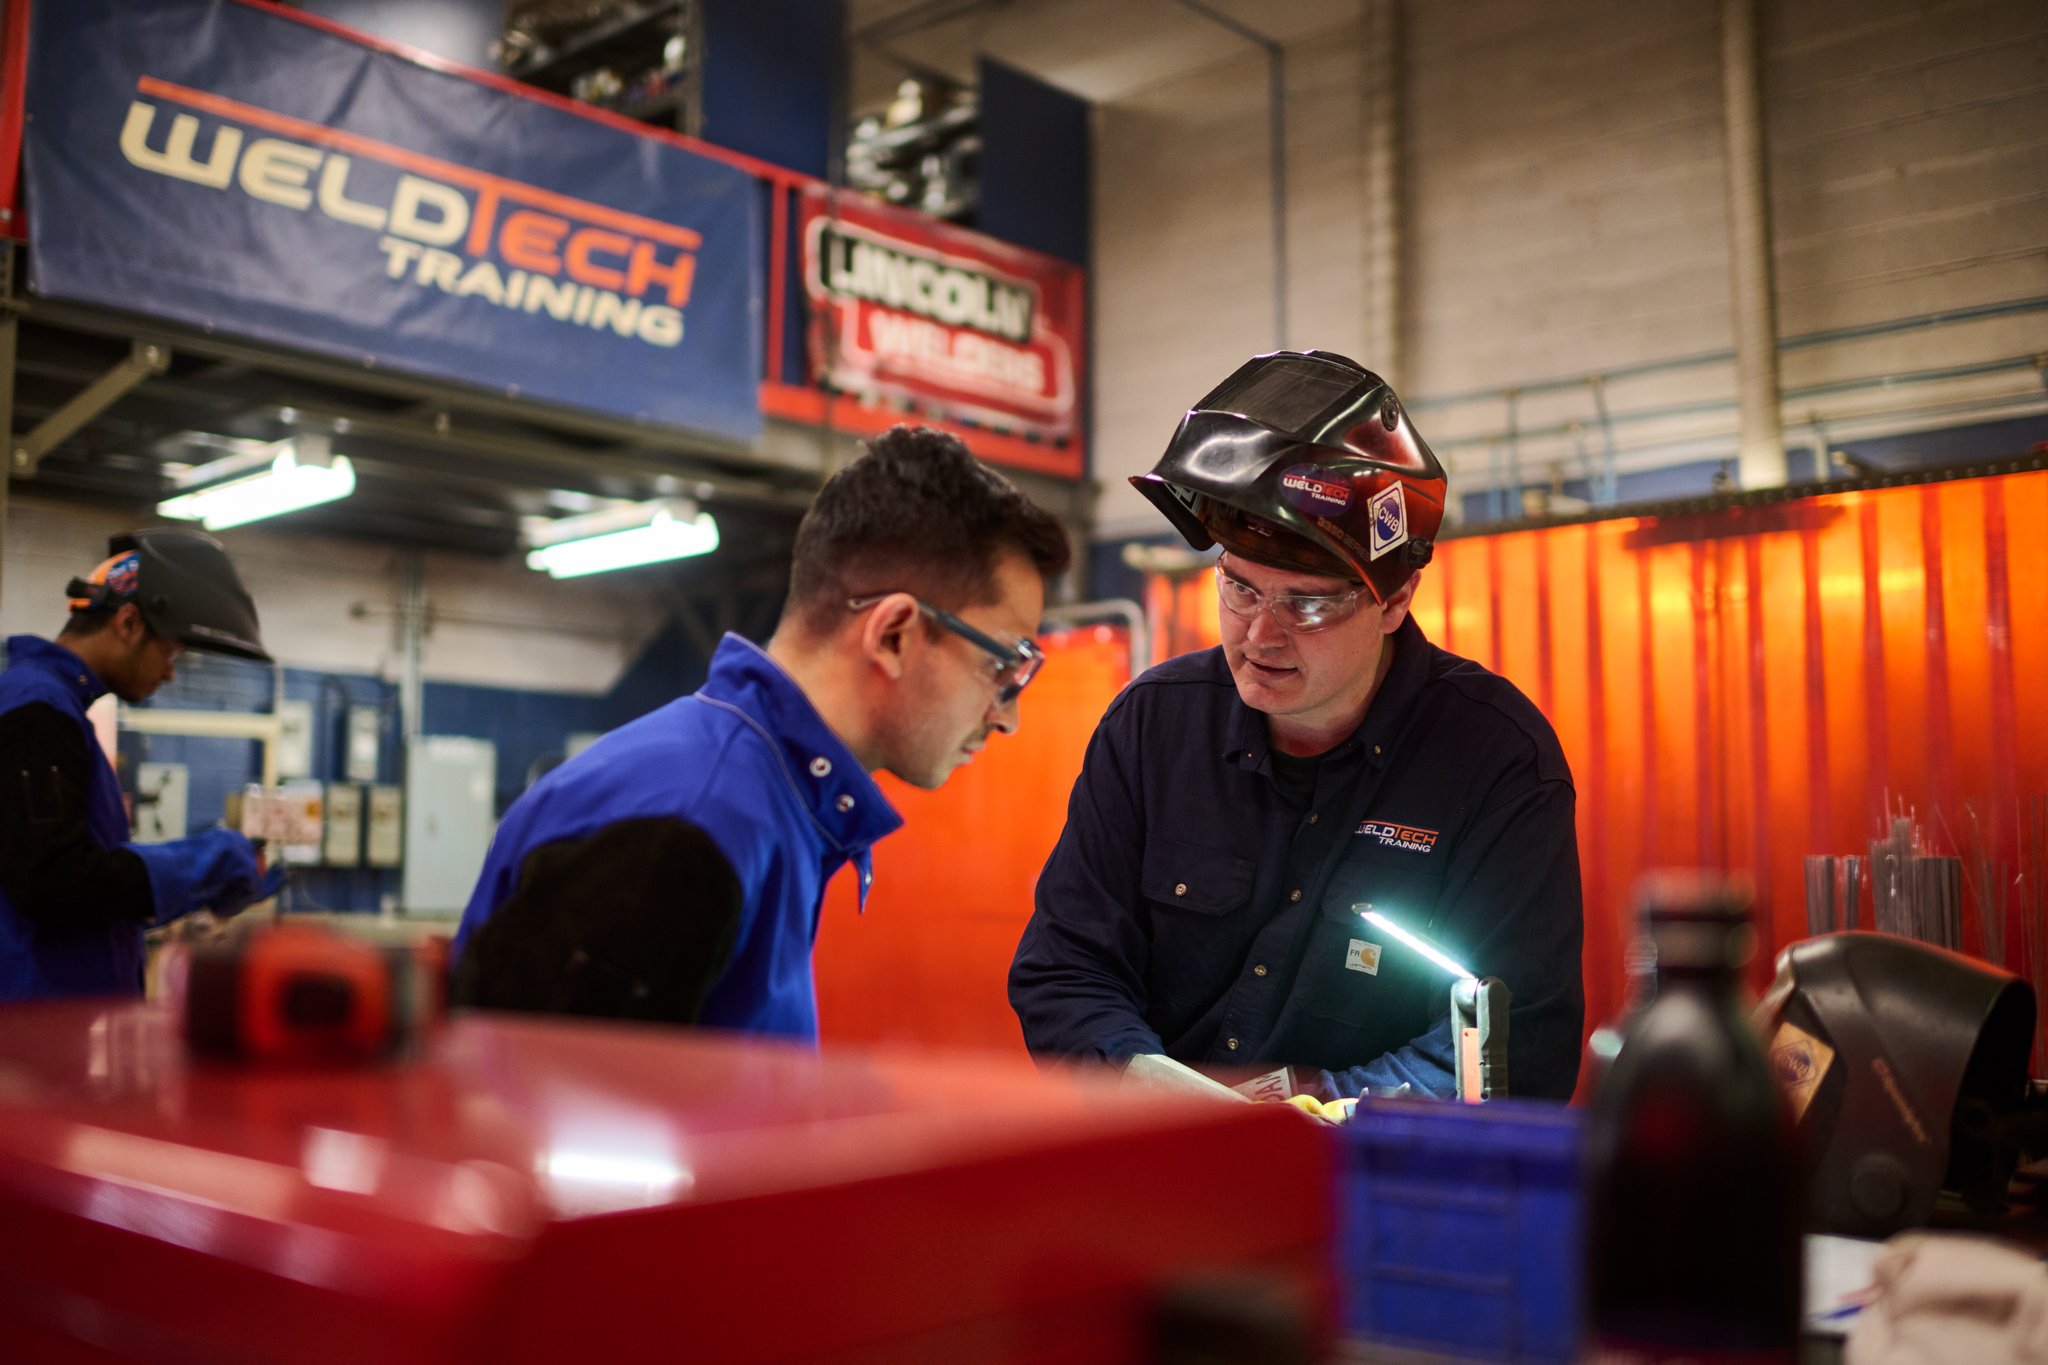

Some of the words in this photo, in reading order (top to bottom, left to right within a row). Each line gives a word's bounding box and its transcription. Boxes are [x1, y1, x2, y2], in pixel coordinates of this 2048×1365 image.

[120, 77, 702, 309] WELDTECH
[380, 239, 685, 347] TRAINING
[828, 231, 1032, 343] LINCOLN
[869, 310, 1045, 393] WELDERS
[1282, 474, 1351, 501] WELDTECH
[1311, 492, 1347, 506] TRAINING
[1378, 506, 1400, 532] CWB
[1379, 836, 1432, 853] TRAINING
[1350, 949, 1361, 957] FR
